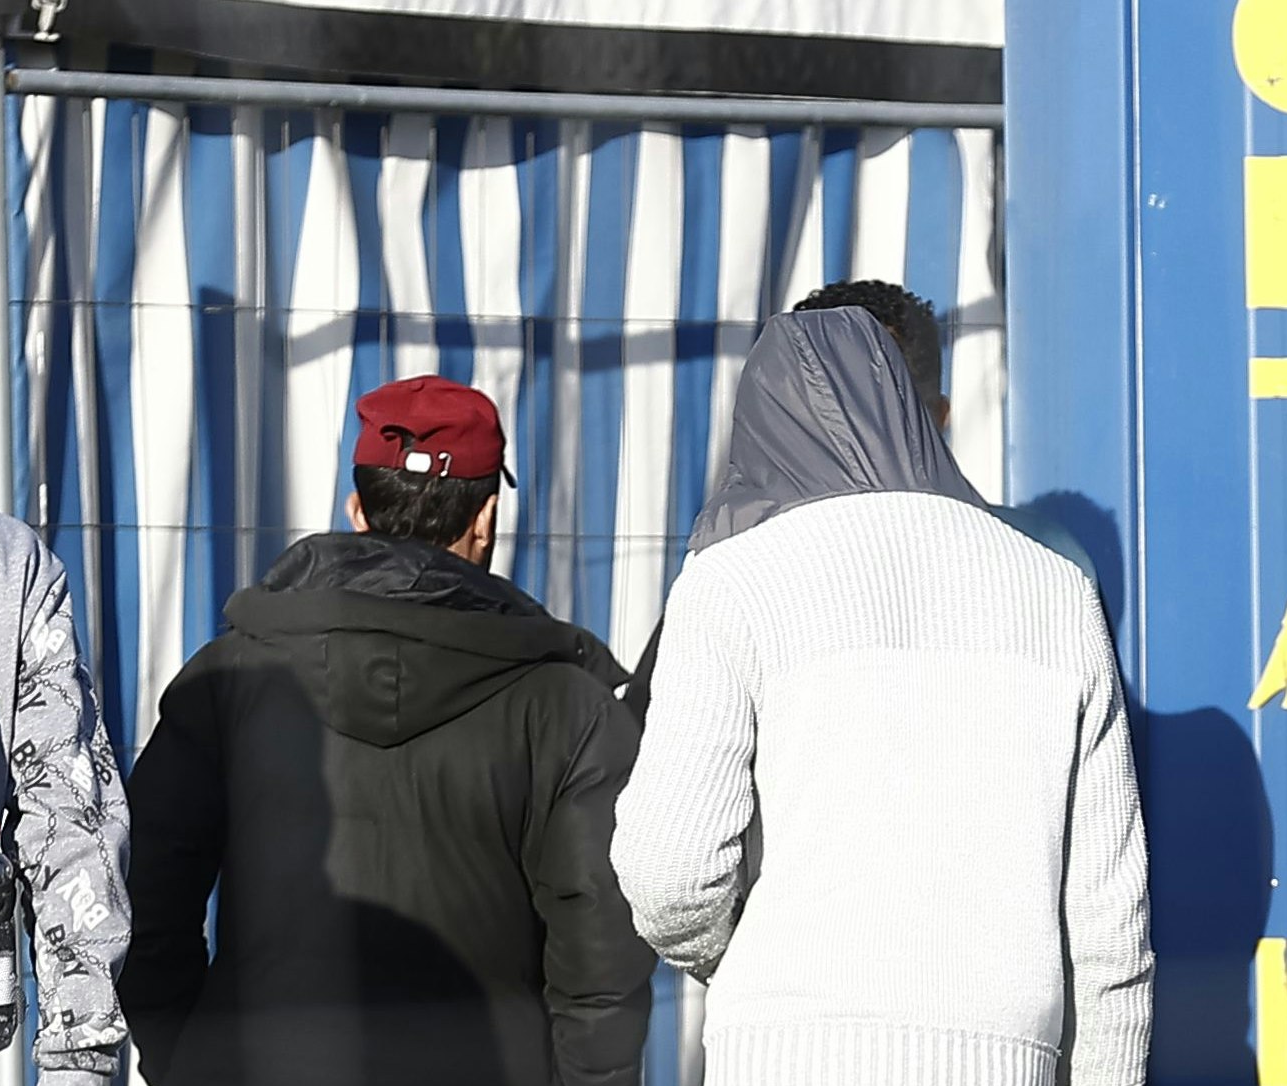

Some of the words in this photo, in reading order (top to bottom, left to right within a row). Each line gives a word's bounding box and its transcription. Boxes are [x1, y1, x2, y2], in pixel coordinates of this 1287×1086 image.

[11, 740, 53, 791] BOY
[56, 873, 110, 931] BOY
[44, 923, 90, 978] BOY
